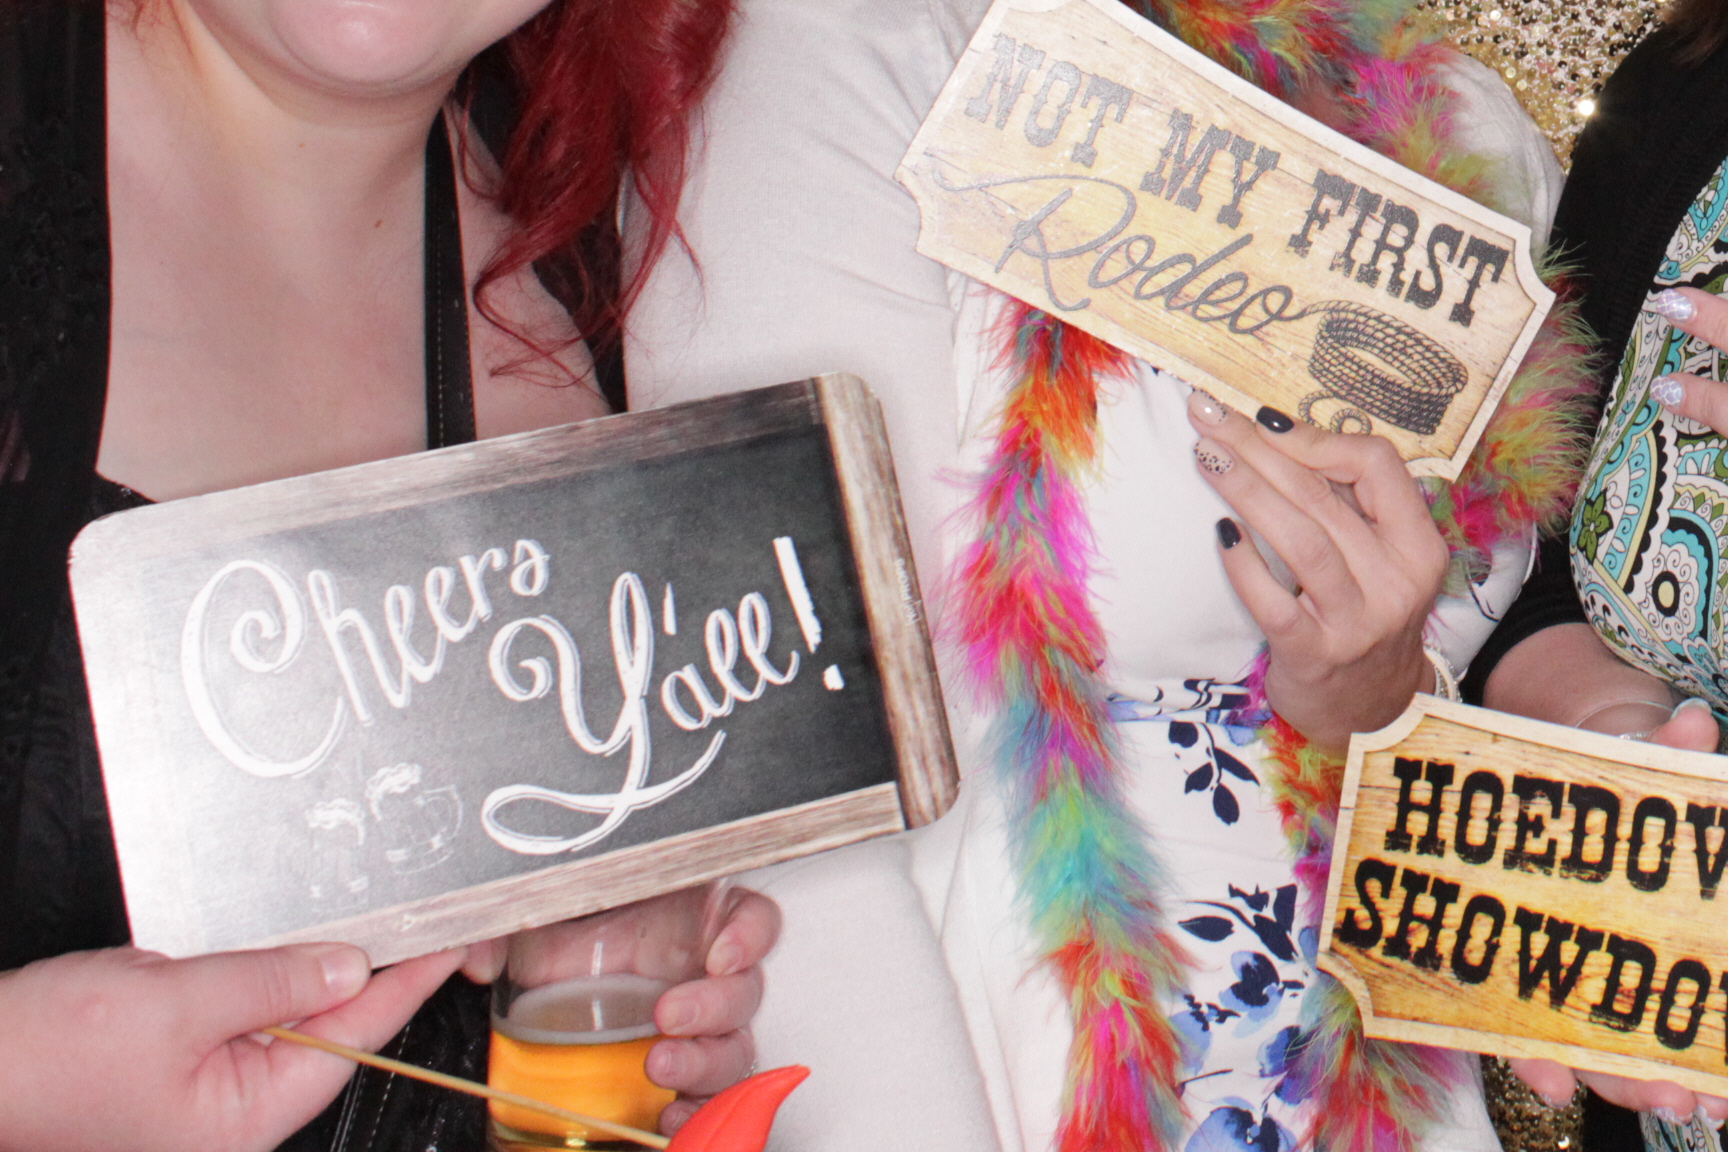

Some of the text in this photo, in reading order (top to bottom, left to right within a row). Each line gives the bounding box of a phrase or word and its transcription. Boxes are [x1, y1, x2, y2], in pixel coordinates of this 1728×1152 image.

[923, 147, 1304, 335] Rodeo
[964, 33, 1509, 328] NOT MY FIRST
[181, 538, 549, 777] Cheers
